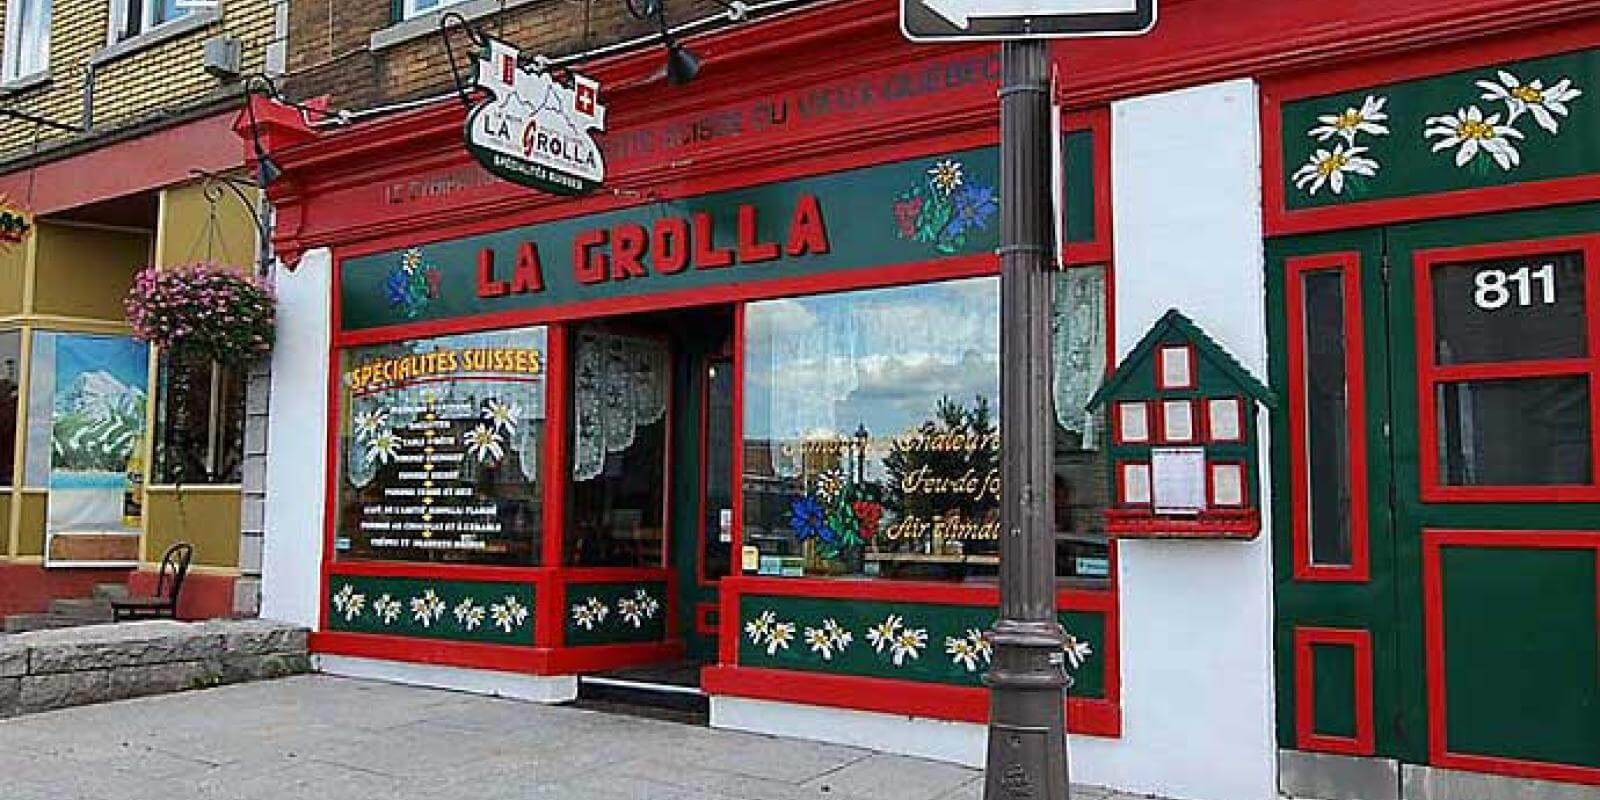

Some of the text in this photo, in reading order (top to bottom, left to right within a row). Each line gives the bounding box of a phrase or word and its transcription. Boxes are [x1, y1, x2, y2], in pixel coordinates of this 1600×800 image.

[484, 115, 511, 141] LA
[523, 119, 597, 169] GROLLA
[475, 193, 831, 298] LA GROLLA
[1475, 264, 1555, 308] 811
[463, 348, 539, 374] SUISSES
